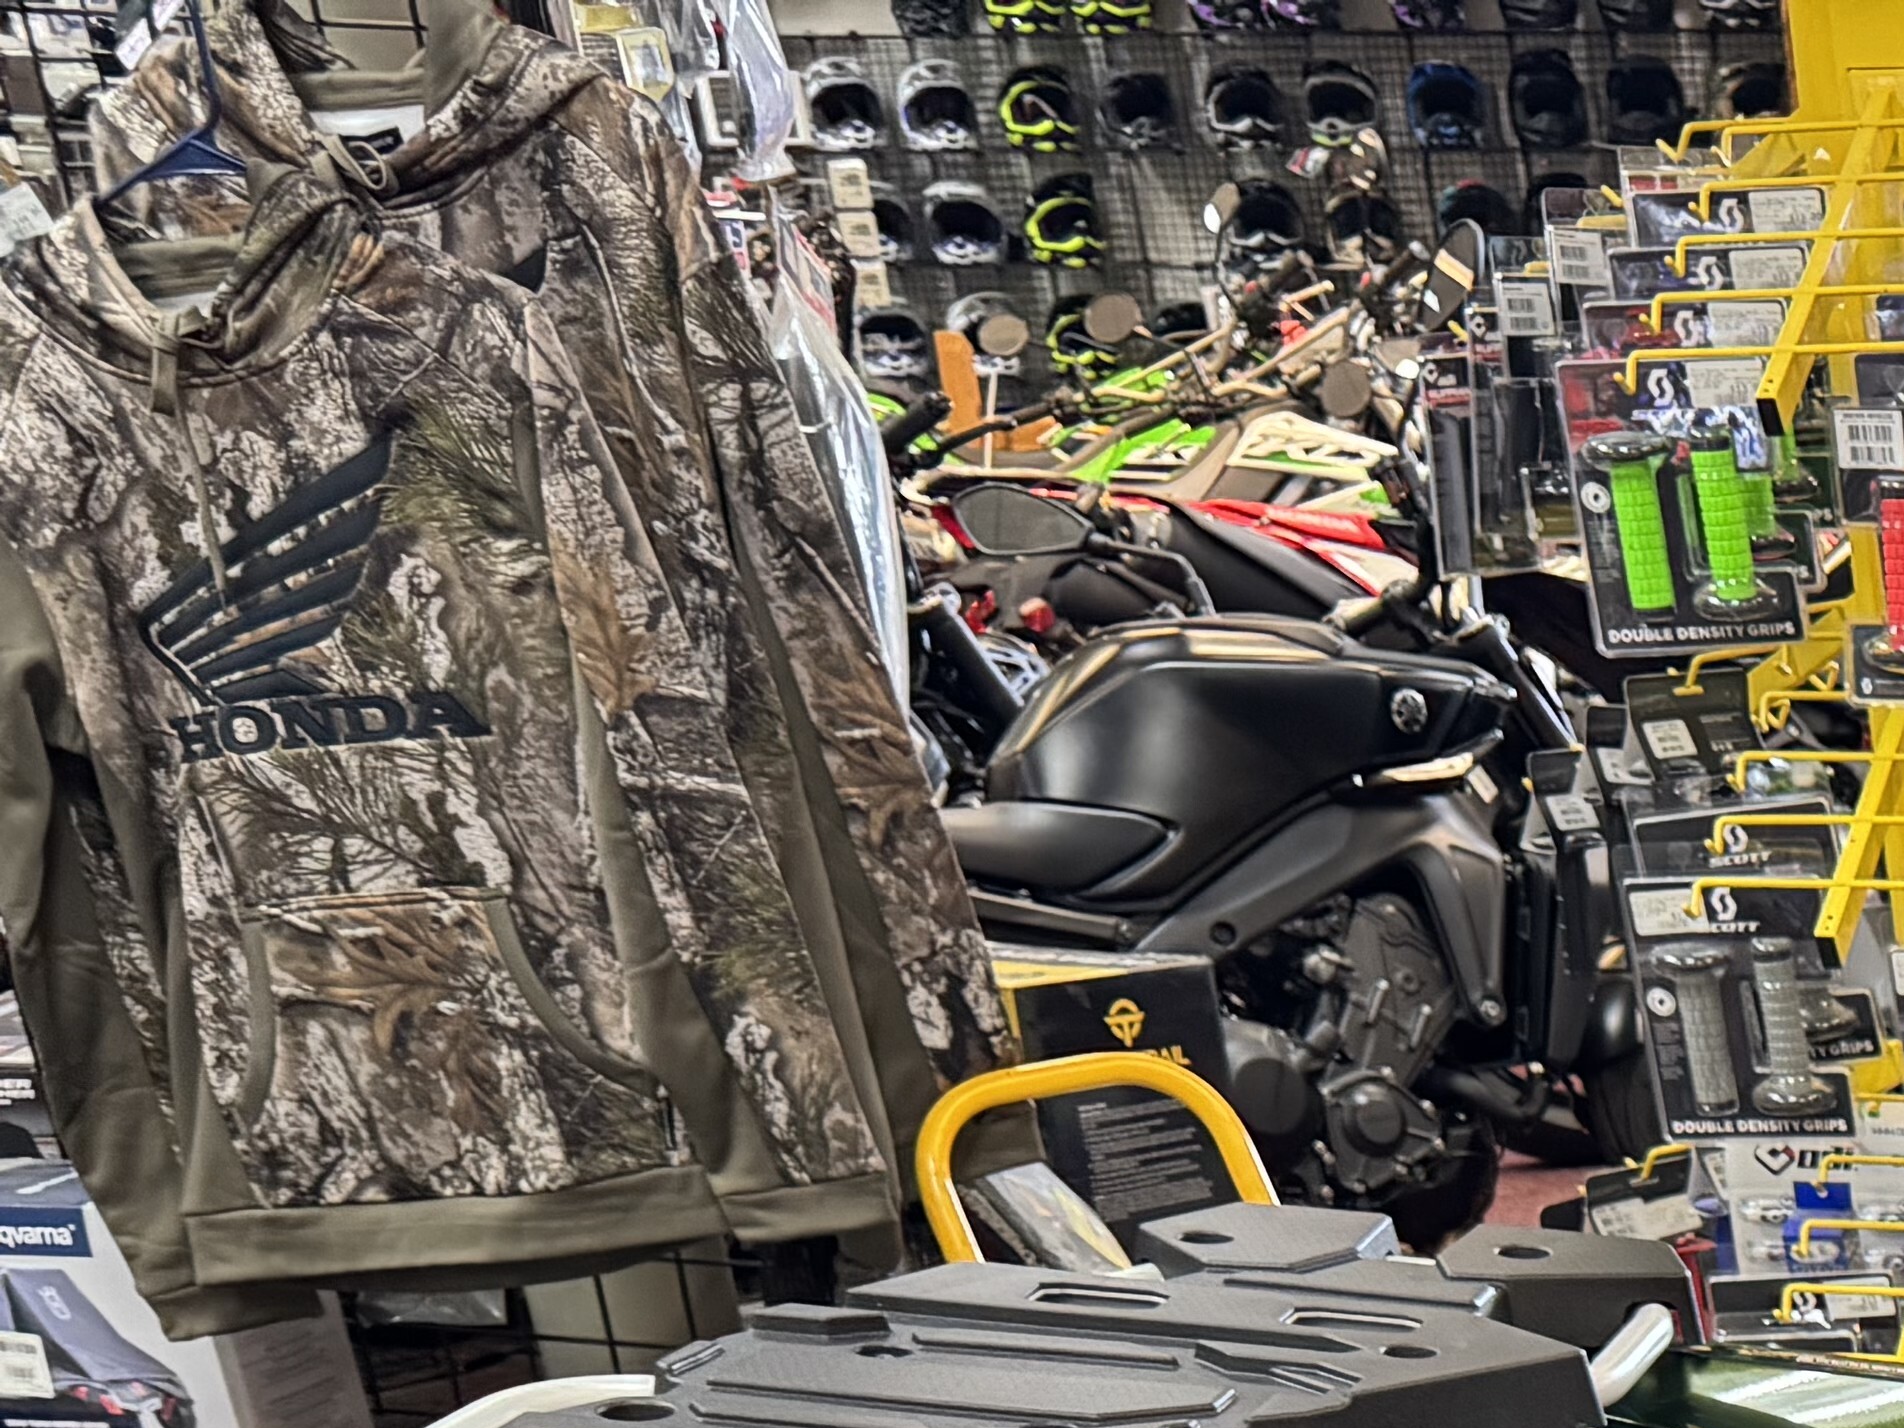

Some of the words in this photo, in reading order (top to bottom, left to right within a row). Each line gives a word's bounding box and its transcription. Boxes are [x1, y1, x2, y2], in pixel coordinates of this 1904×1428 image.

[1608, 627, 1675, 644] DOUBLE
[1677, 625, 1745, 641] DENSITY
[1747, 621, 1796, 637] GRIPS
[167, 690, 493, 765] HONDA
[1672, 1119, 1736, 1135] DOUBLE
[1736, 1119, 1802, 1134] DENSITY
[1802, 1118, 1848, 1133] GRIPS
